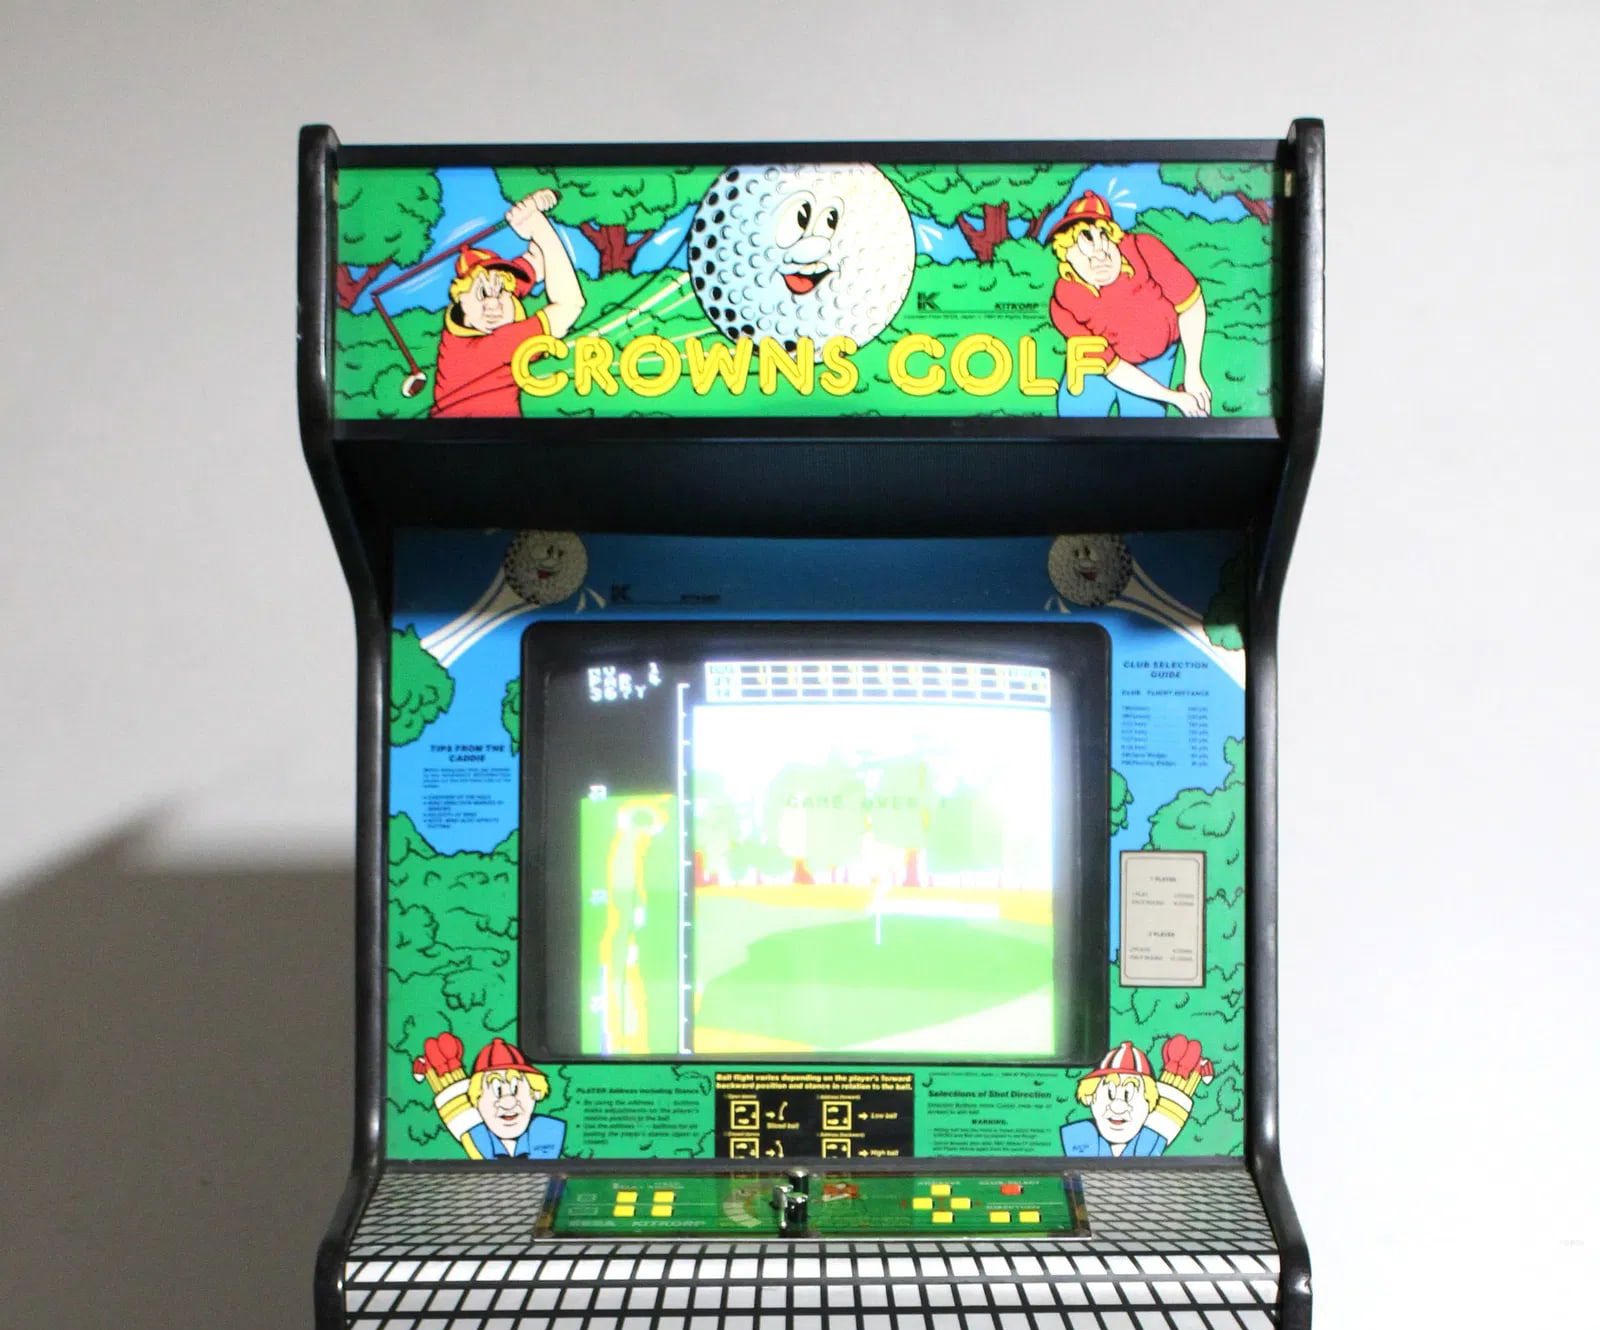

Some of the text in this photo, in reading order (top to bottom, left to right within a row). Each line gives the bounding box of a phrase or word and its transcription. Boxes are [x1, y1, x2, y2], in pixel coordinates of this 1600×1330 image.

[995, 302, 1039, 312] KITKORP
[511, 333, 1108, 397] CROWNS GOLF
[1123, 661, 1208, 669] CLUB SELECTION
[430, 744, 505, 752] TIPS FROM THE
[448, 754, 485, 762] CADDIE
[733, 1074, 754, 1082] flight
[780, 1074, 821, 1082] depending
[834, 1074, 847, 1082] the
[848, 1075, 879, 1083] player's
[755, 1082, 787, 1090] position
[928, 1090, 976, 1098] Selections
[989, 1090, 1009, 1098] Shot
[1010, 1090, 1052, 1098] Direction
